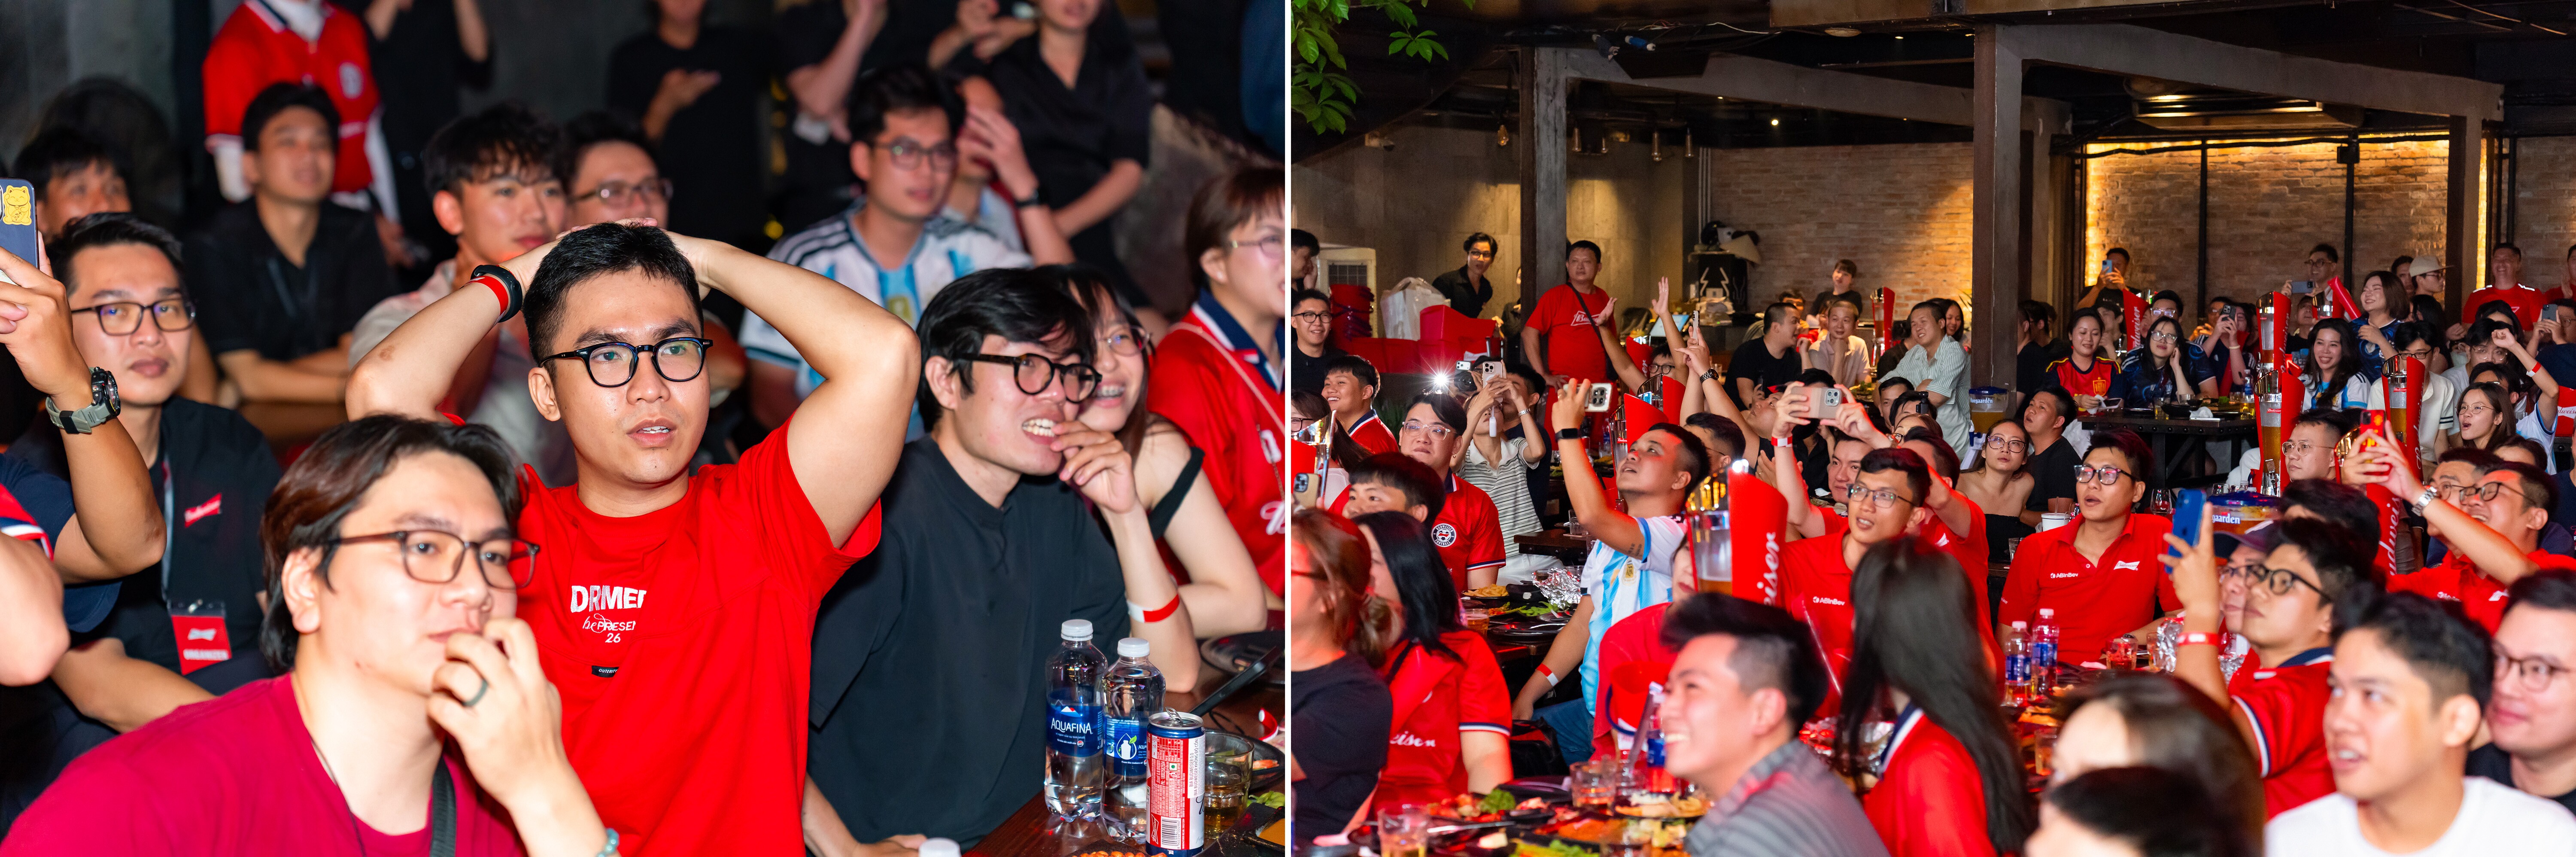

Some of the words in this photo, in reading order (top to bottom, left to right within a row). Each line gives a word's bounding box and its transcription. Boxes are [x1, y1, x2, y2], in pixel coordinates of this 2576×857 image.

[1820, 598, 1845, 606] ABInBev
[605, 633, 621, 643] 26
[1051, 718, 1092, 734] AQUAFINA
